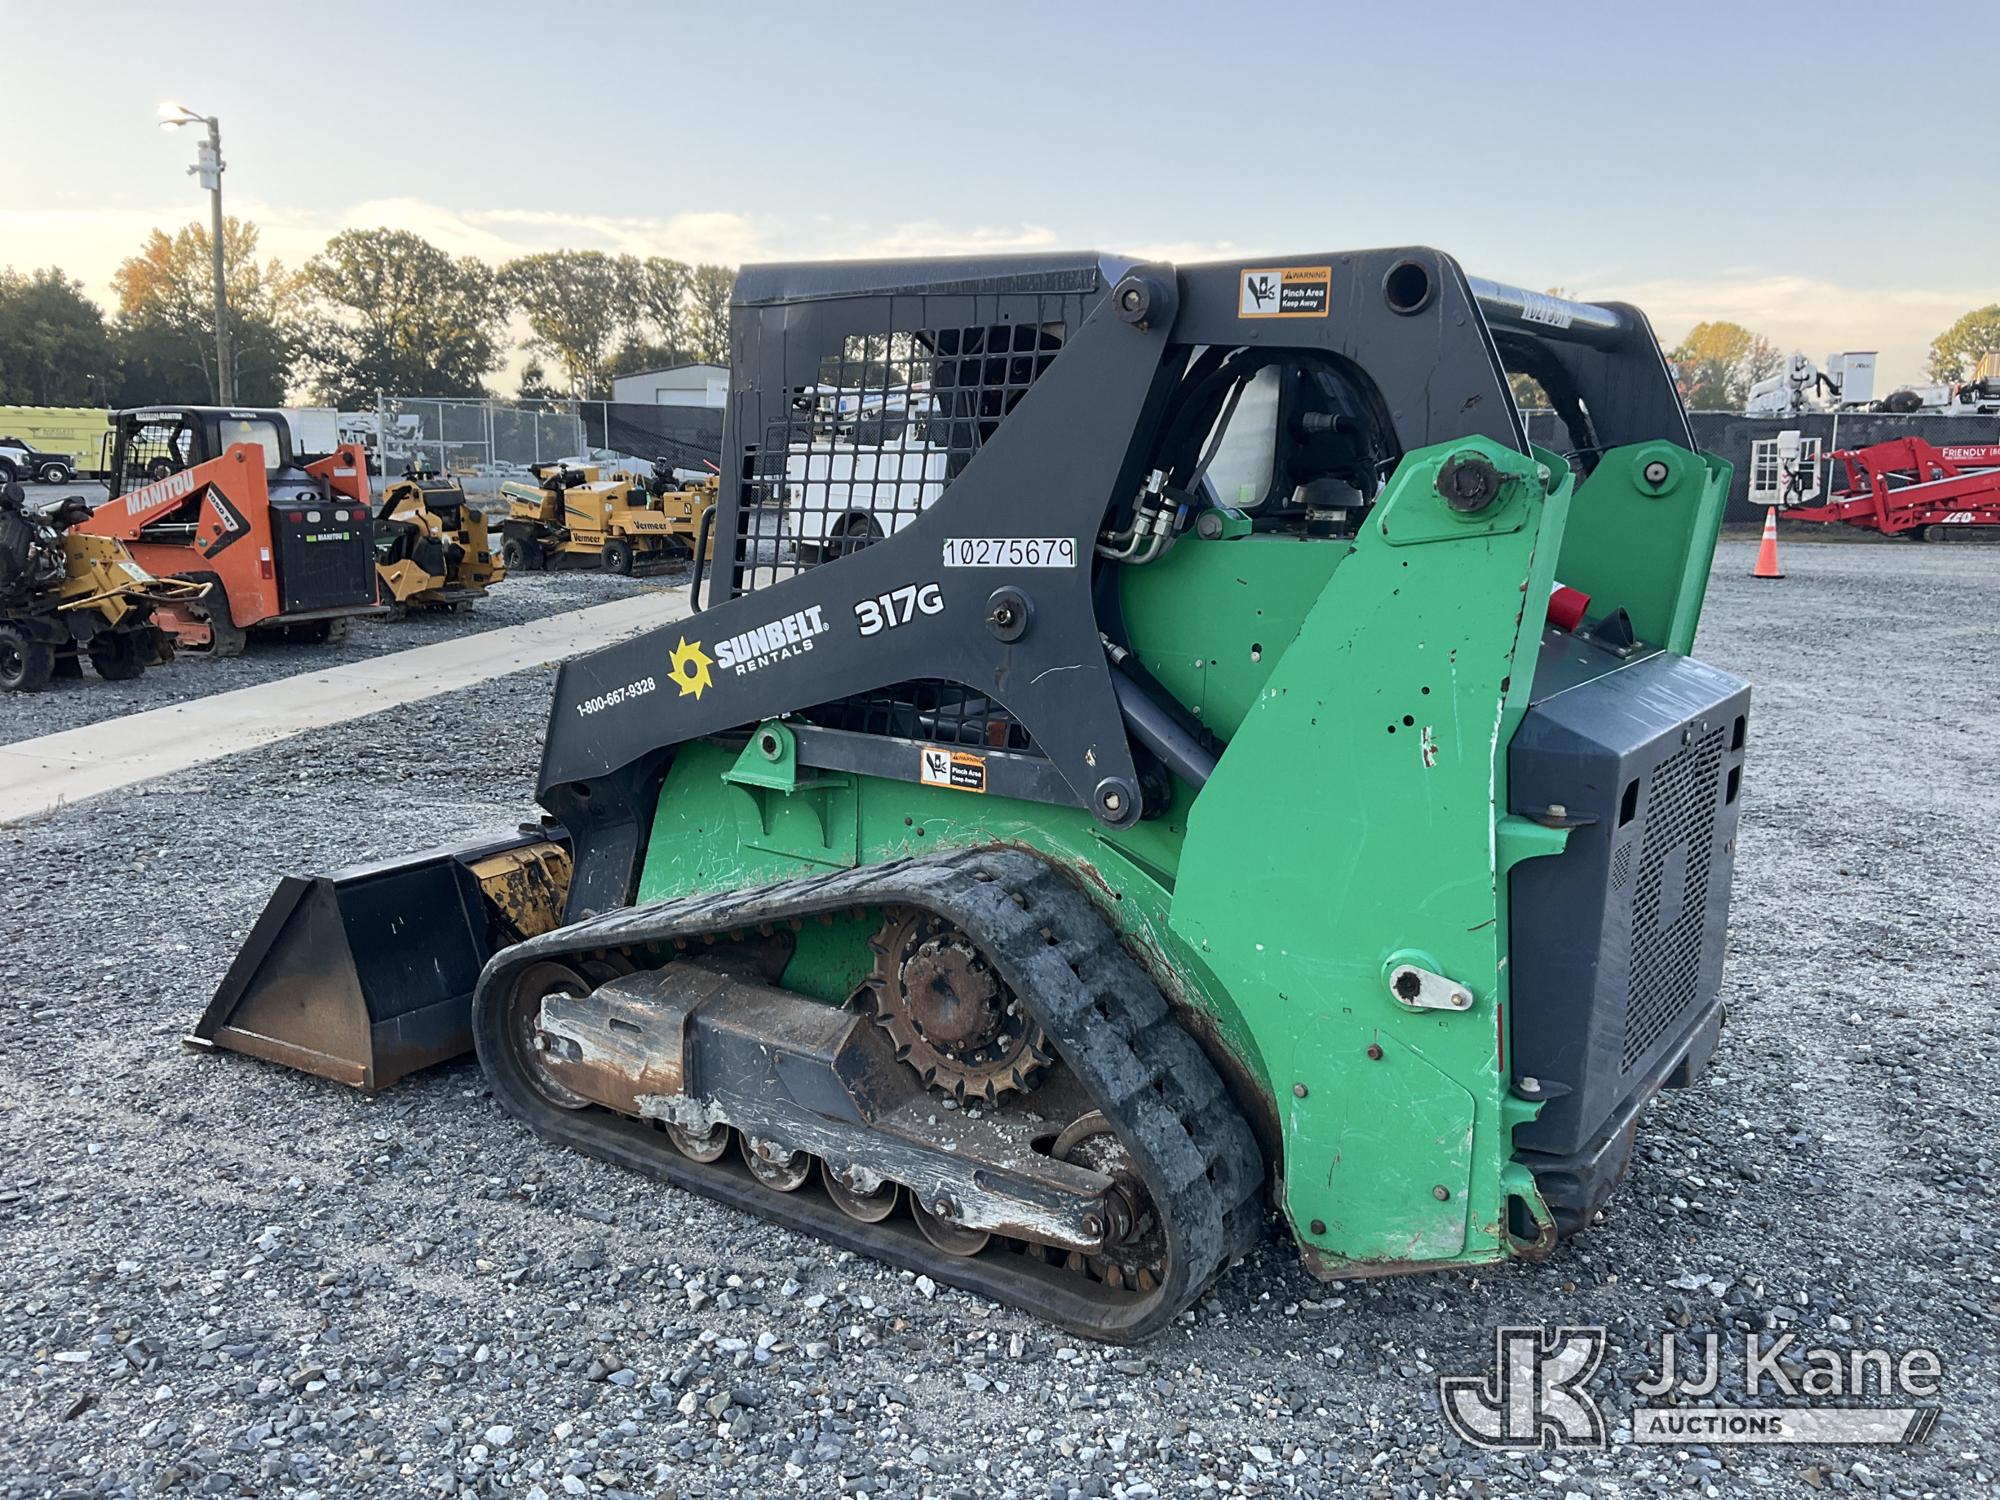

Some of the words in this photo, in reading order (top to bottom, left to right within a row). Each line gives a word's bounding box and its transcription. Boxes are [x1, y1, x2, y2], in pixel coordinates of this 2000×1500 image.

[1293, 271, 1327, 279] WARNING
[1283, 289, 1304, 297] Pinch
[1306, 289, 1324, 297] Area
[1282, 300, 1298, 308] Keep
[1300, 300, 1318, 308] Away
[1942, 447, 1987, 458] FRIENDLY
[126, 470, 195, 516] MANITOU
[208, 492, 225, 515] 1050
[634, 521, 667, 531] Vermeer
[573, 533, 600, 543] Vermeer
[946, 540, 1074, 565] 10275679
[854, 583, 945, 637] 317G
[735, 639, 814, 676] RENTALS
[576, 677, 656, 717] 1-800-667-9328
[952, 767, 967, 775] Pinch
[964, 777, 977, 785] Away
